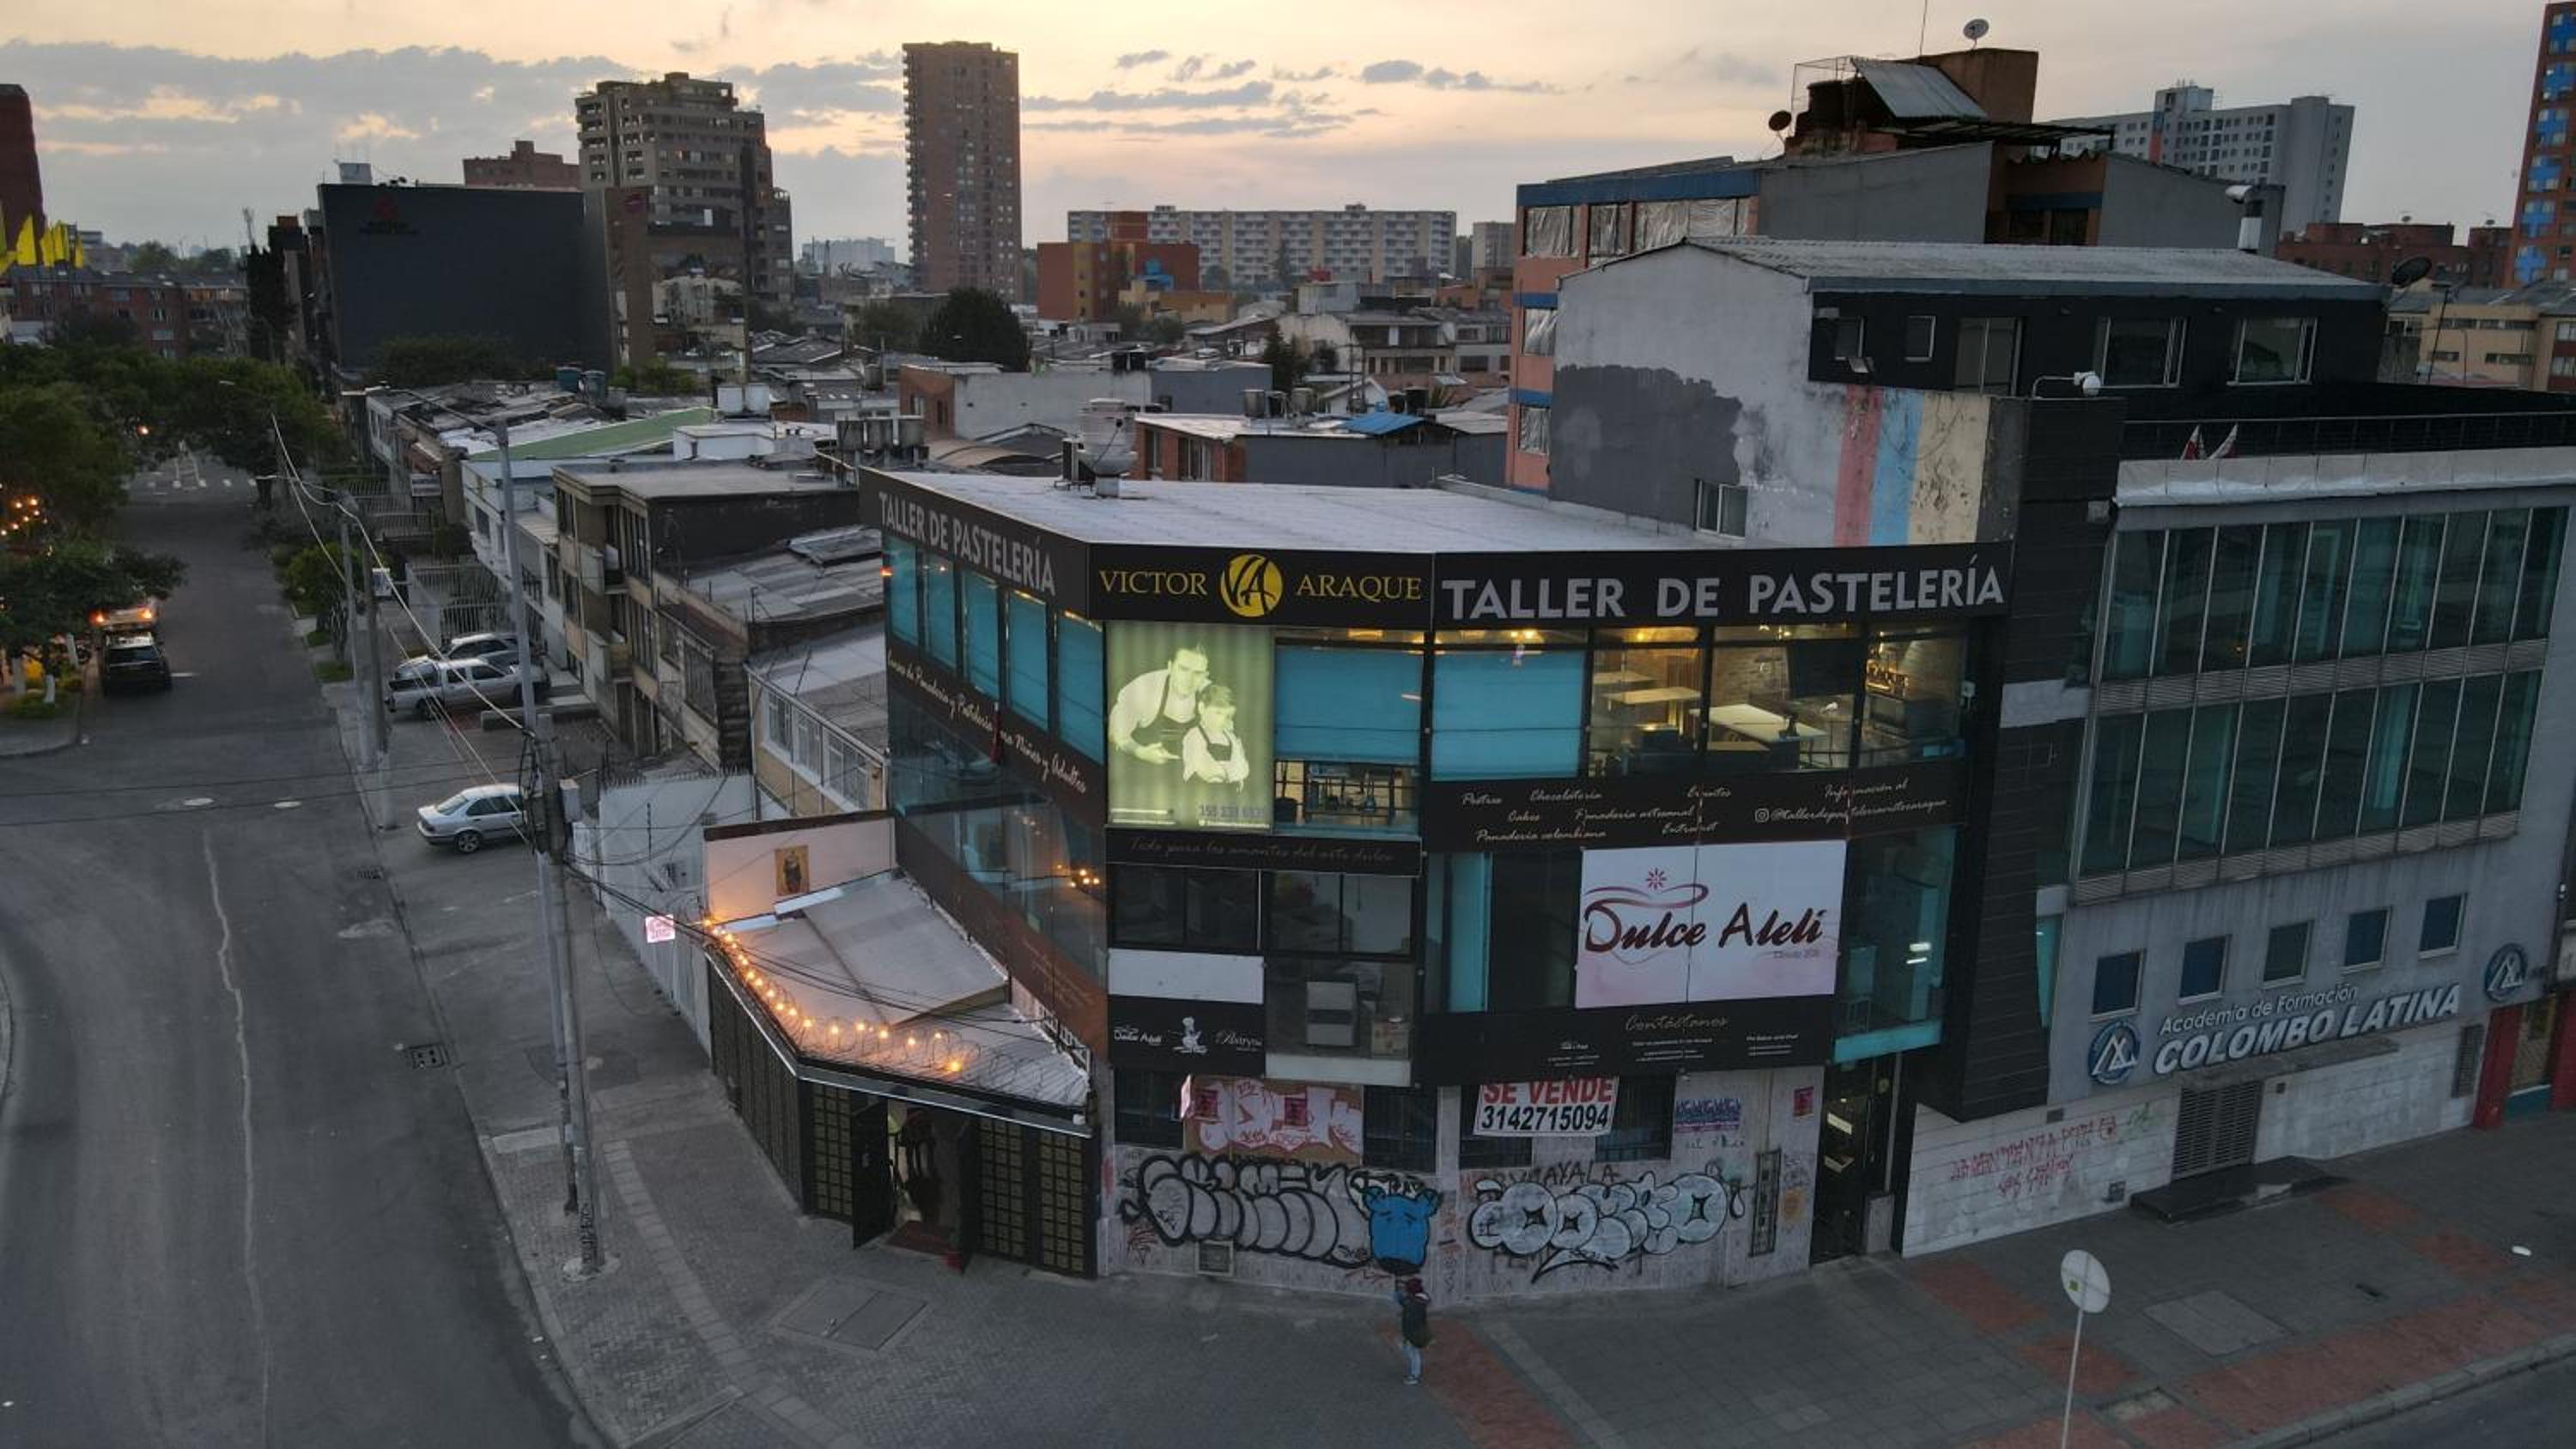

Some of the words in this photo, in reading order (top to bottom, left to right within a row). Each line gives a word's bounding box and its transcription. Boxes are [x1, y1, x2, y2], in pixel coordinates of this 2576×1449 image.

[878, 491, 927, 542] TALLER
[929, 508, 949, 550] DE
[953, 523, 1056, 597] PASTELERÍA
[1098, 569, 1207, 596] VICTOR
[1295, 576, 1422, 603] ARAQUE
[1442, 578, 1626, 620] TALLER
[1656, 577, 1720, 617] DE
[1747, 555, 2005, 615] PASTELERÍA
[1583, 899, 1706, 953] Dulce
[2154, 1006, 2337, 1076] COLOMBO
[2339, 983, 2460, 1039] LATINA
[2159, 1005, 2247, 1036] Academia
[2251, 999, 2273, 1018] de
[2276, 983, 2359, 1016] Formación
[1483, 1083, 1518, 1105] SE
[1528, 1076, 1613, 1105] VENDE
[1481, 1104, 1610, 1131] 3142715094
